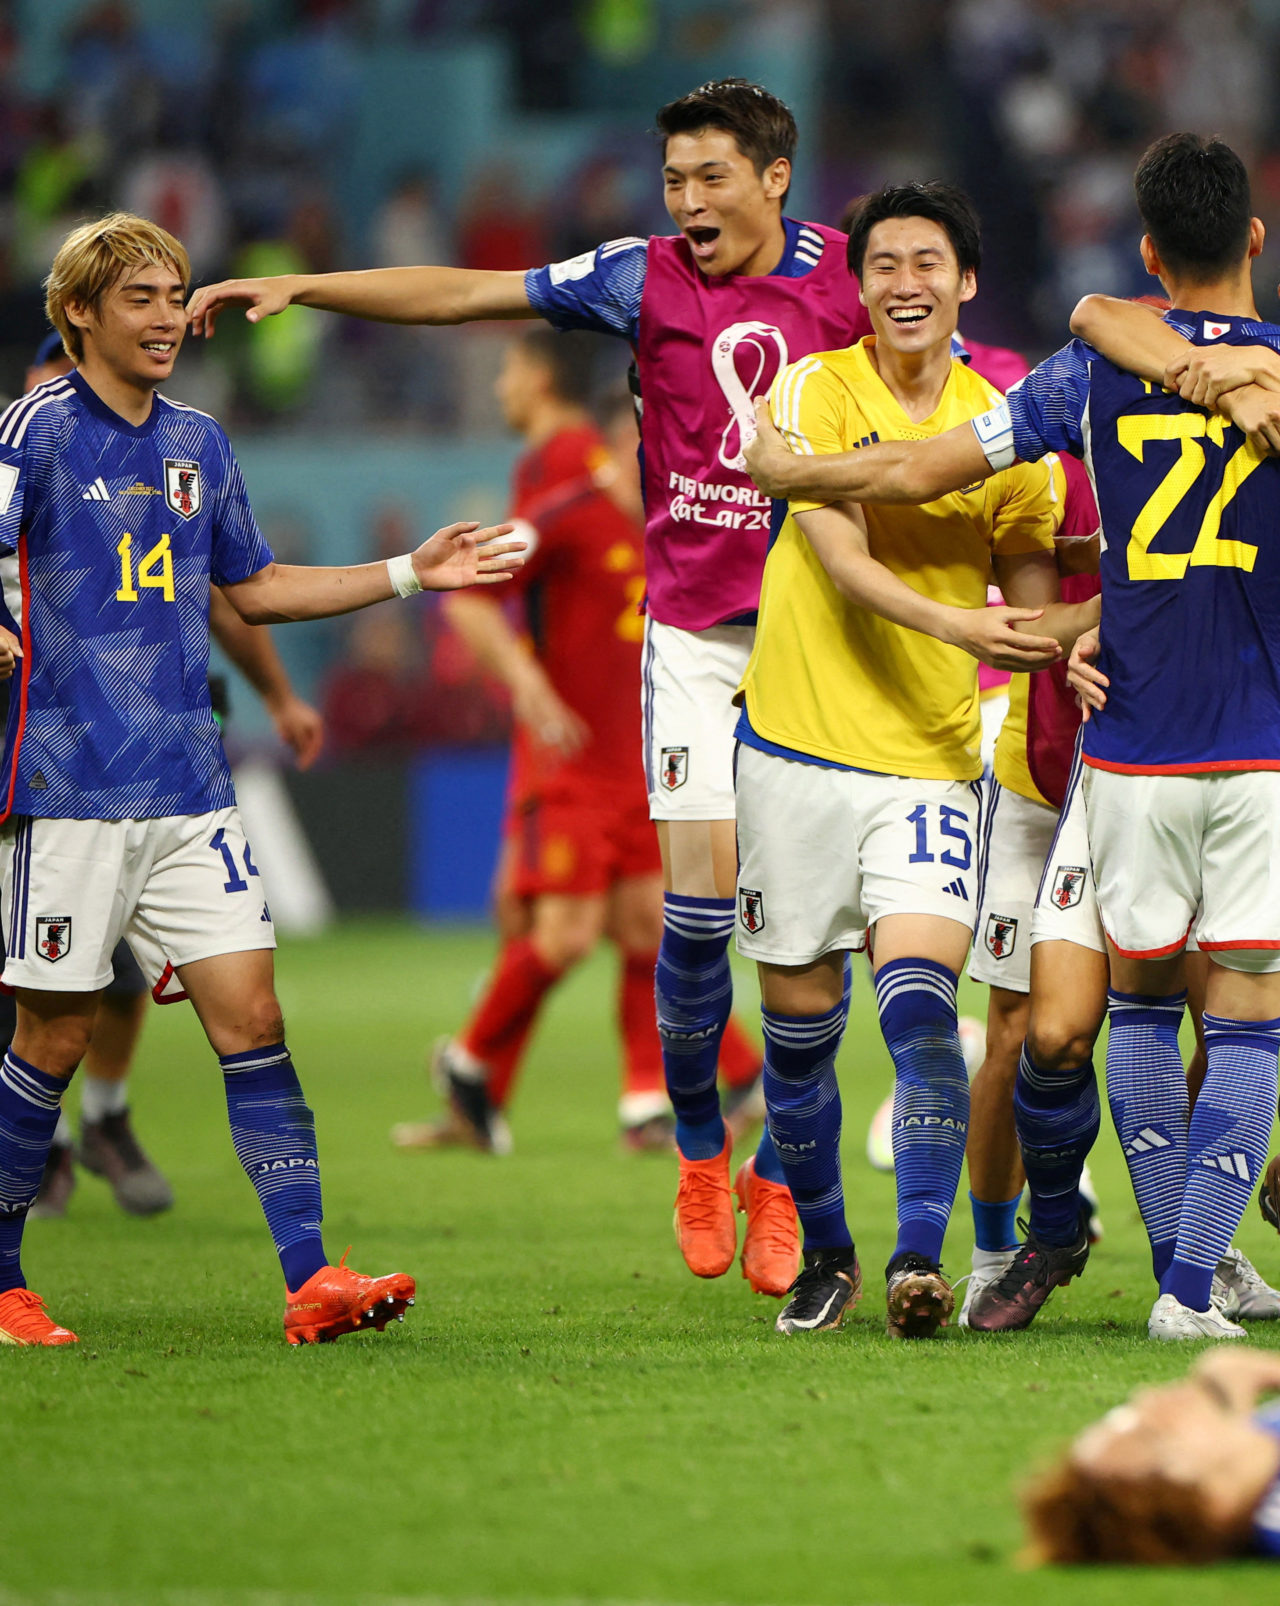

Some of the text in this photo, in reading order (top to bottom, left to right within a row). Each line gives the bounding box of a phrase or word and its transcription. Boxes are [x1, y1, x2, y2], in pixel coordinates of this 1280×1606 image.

[1117, 412, 1268, 581] 22
[117, 532, 176, 602] 14
[905, 804, 972, 871] 15
[897, 1116, 966, 1133] JAPAN
[258, 1158, 320, 1174] JAPA
[293, 1302, 322, 1311] ULTRA
